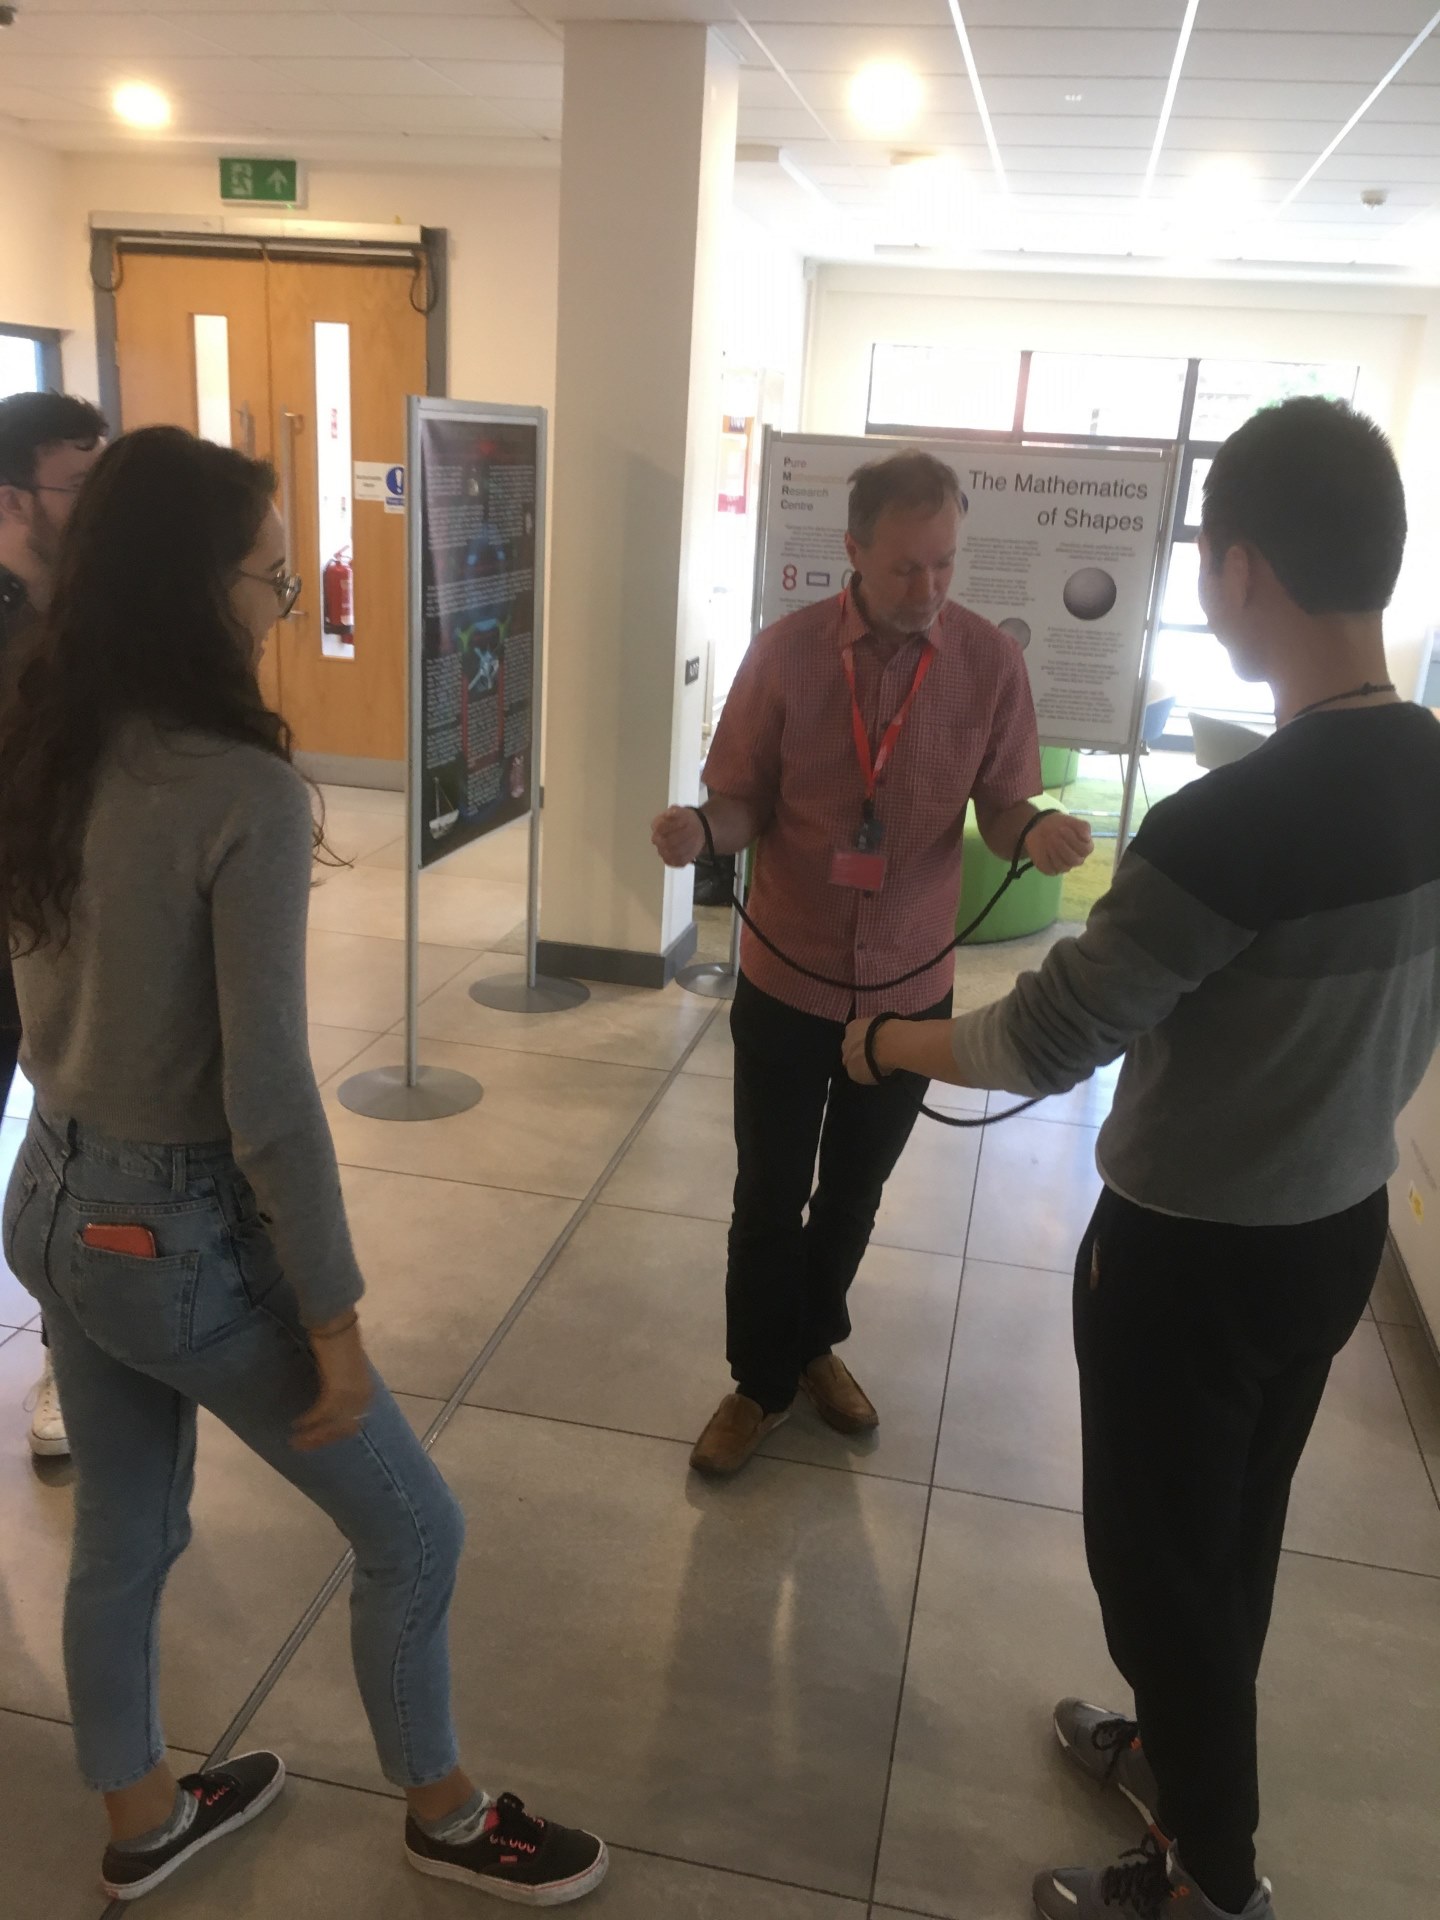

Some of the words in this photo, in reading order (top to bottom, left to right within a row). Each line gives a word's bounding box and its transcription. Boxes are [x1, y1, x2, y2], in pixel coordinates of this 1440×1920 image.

[783, 456, 807, 469] Pure
[781, 485, 829, 497] Research
[968, 470, 1007, 492] The
[1014, 473, 1148, 500] Mathematics
[780, 499, 814, 511] Centre
[1036, 507, 1058, 527] of
[1063, 508, 1144, 534] Shapes
